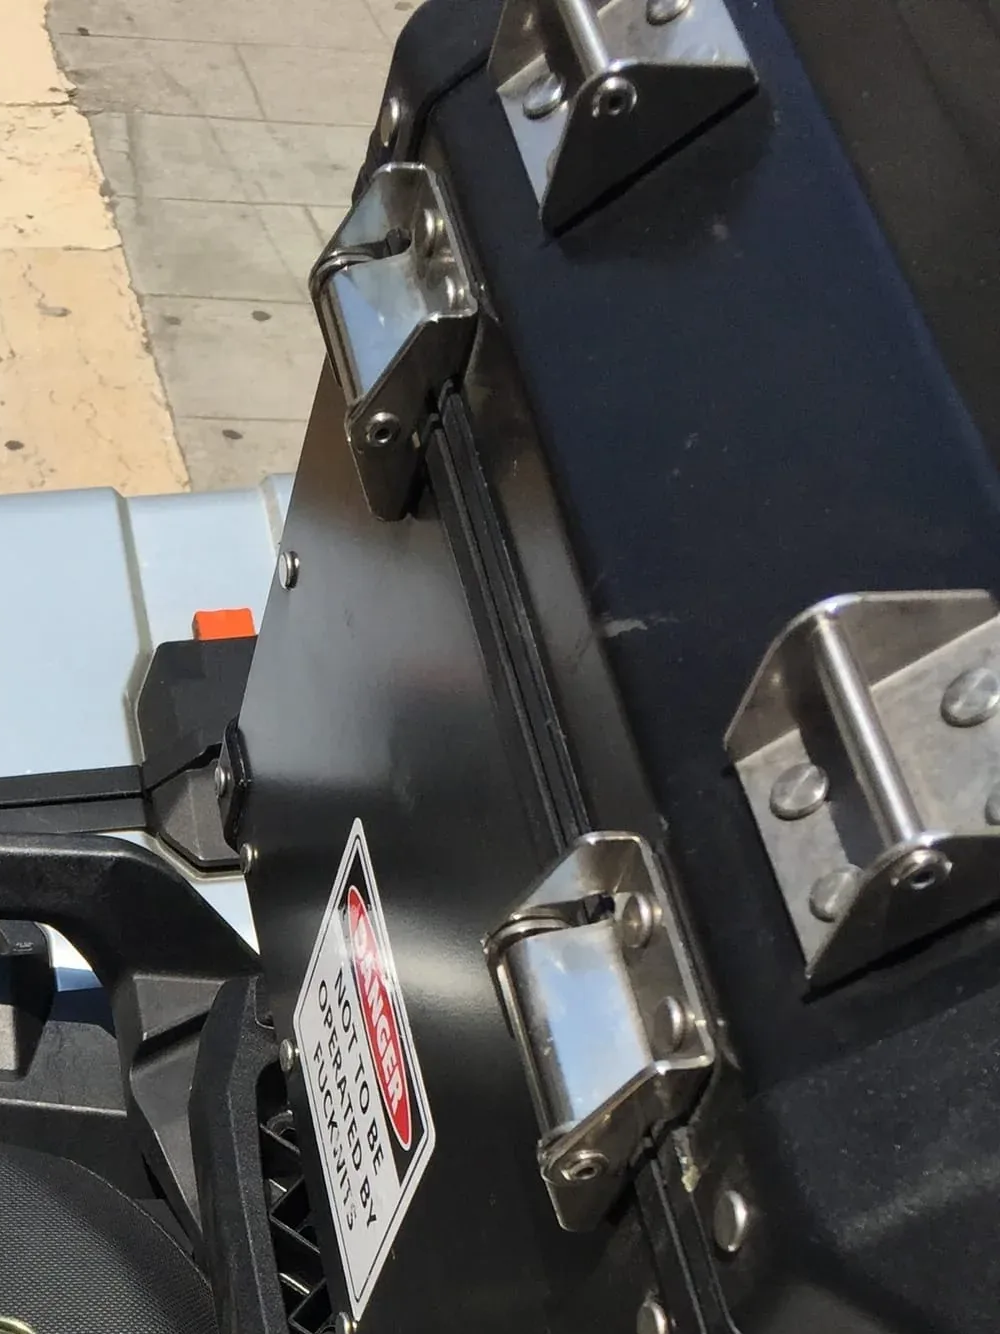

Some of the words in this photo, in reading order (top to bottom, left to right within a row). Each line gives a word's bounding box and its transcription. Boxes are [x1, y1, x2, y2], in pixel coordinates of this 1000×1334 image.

[318, 979, 362, 1172] OPERATED
[360, 1175, 377, 1228] BY
[334, 968, 358, 1052] NOT
[354, 1054, 370, 1114] TO
[367, 1117, 385, 1176] BE
[353, 913, 403, 1115] DANGER
[313, 1040, 357, 1231] FUCKWITS
